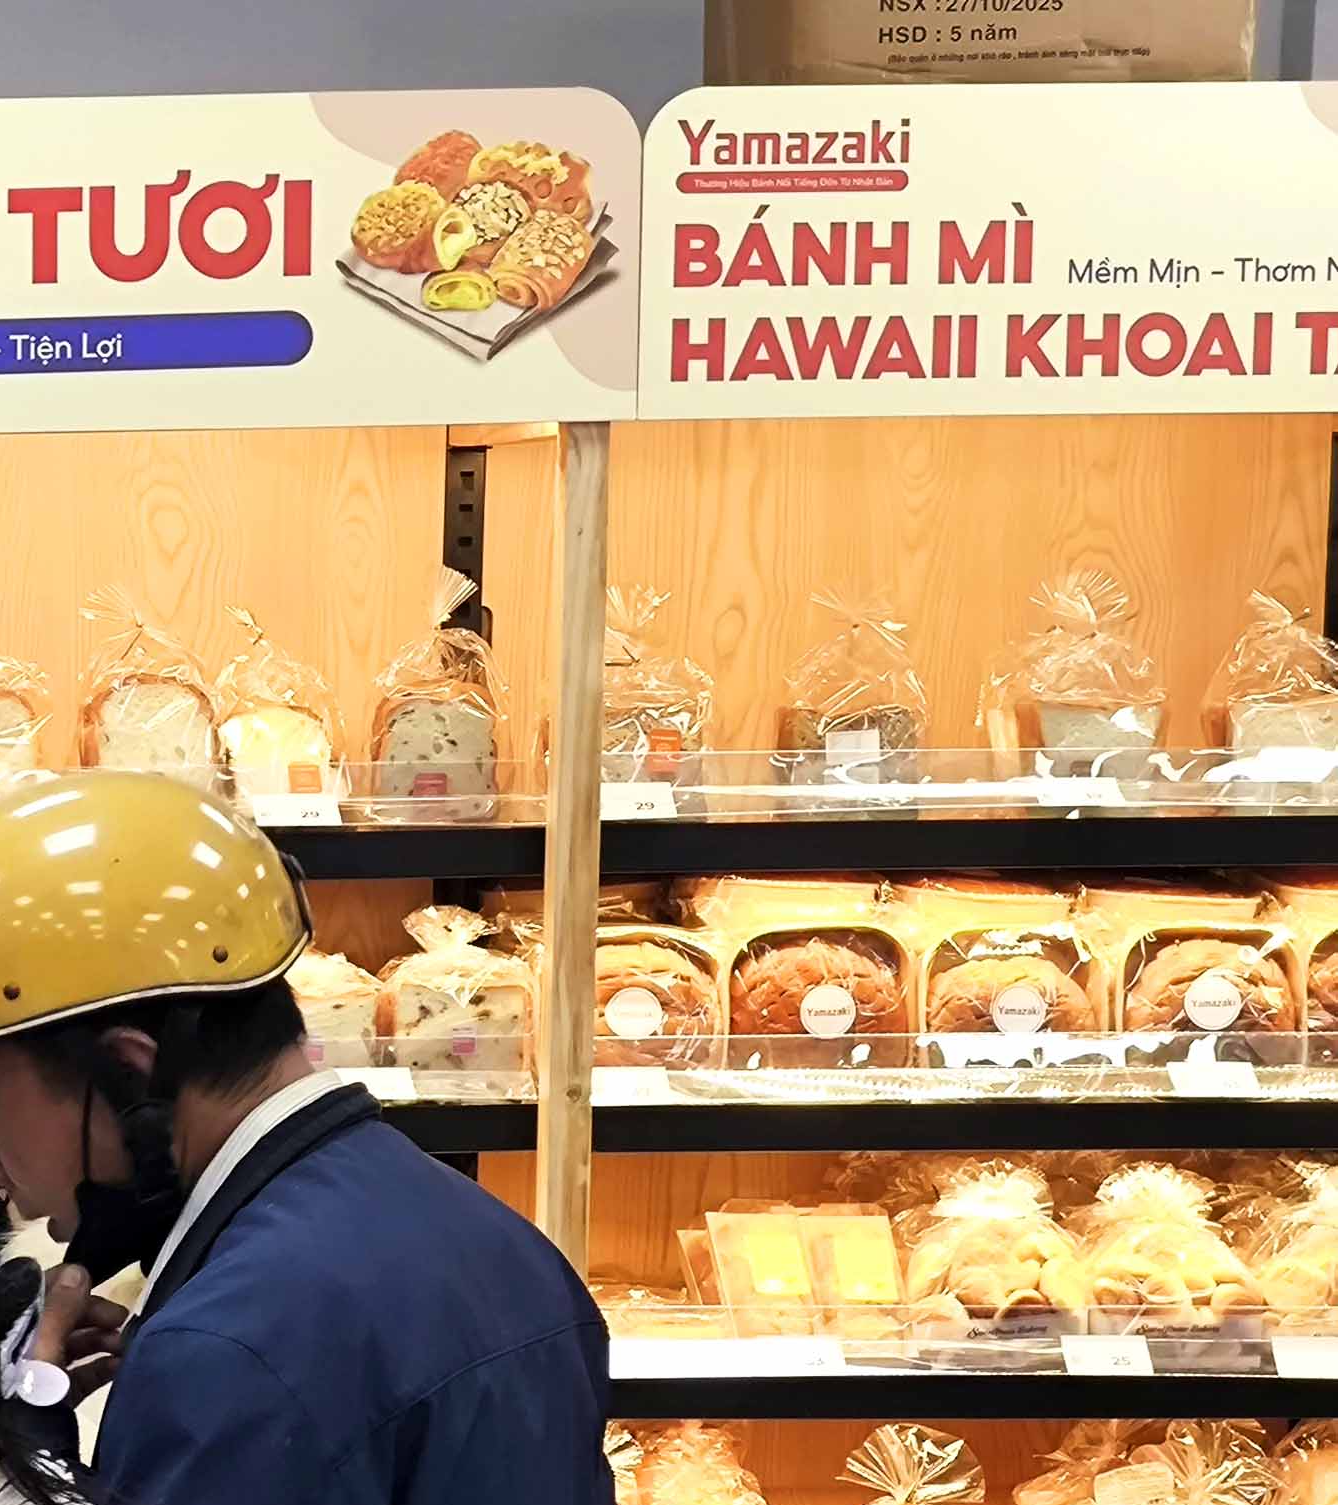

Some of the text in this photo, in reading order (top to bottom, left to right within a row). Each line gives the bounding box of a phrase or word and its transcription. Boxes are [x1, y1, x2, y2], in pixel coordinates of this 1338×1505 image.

[878, 25, 1019, 44] HSD 5 năm
[677, 118, 911, 165] Yamazaki
[7, 168, 313, 285] TƯƠI
[674, 201, 1035, 288] BÁNH MÌ
[1068, 257, 1139, 285] Mềm
[1149, 258, 1201, 289] Mịn
[1233, 256, 1317, 283] Thơm
[8, 331, 73, 365] Tiện
[81, 331, 125, 364] Lợi
[670, 312, 1274, 384] HAWAII KHOAI
[807, 1006, 852, 1017] Yamazaki
[996, 1006, 1041, 1017] Yamazaki
[1191, 998, 1236, 1010] Yamazaki
